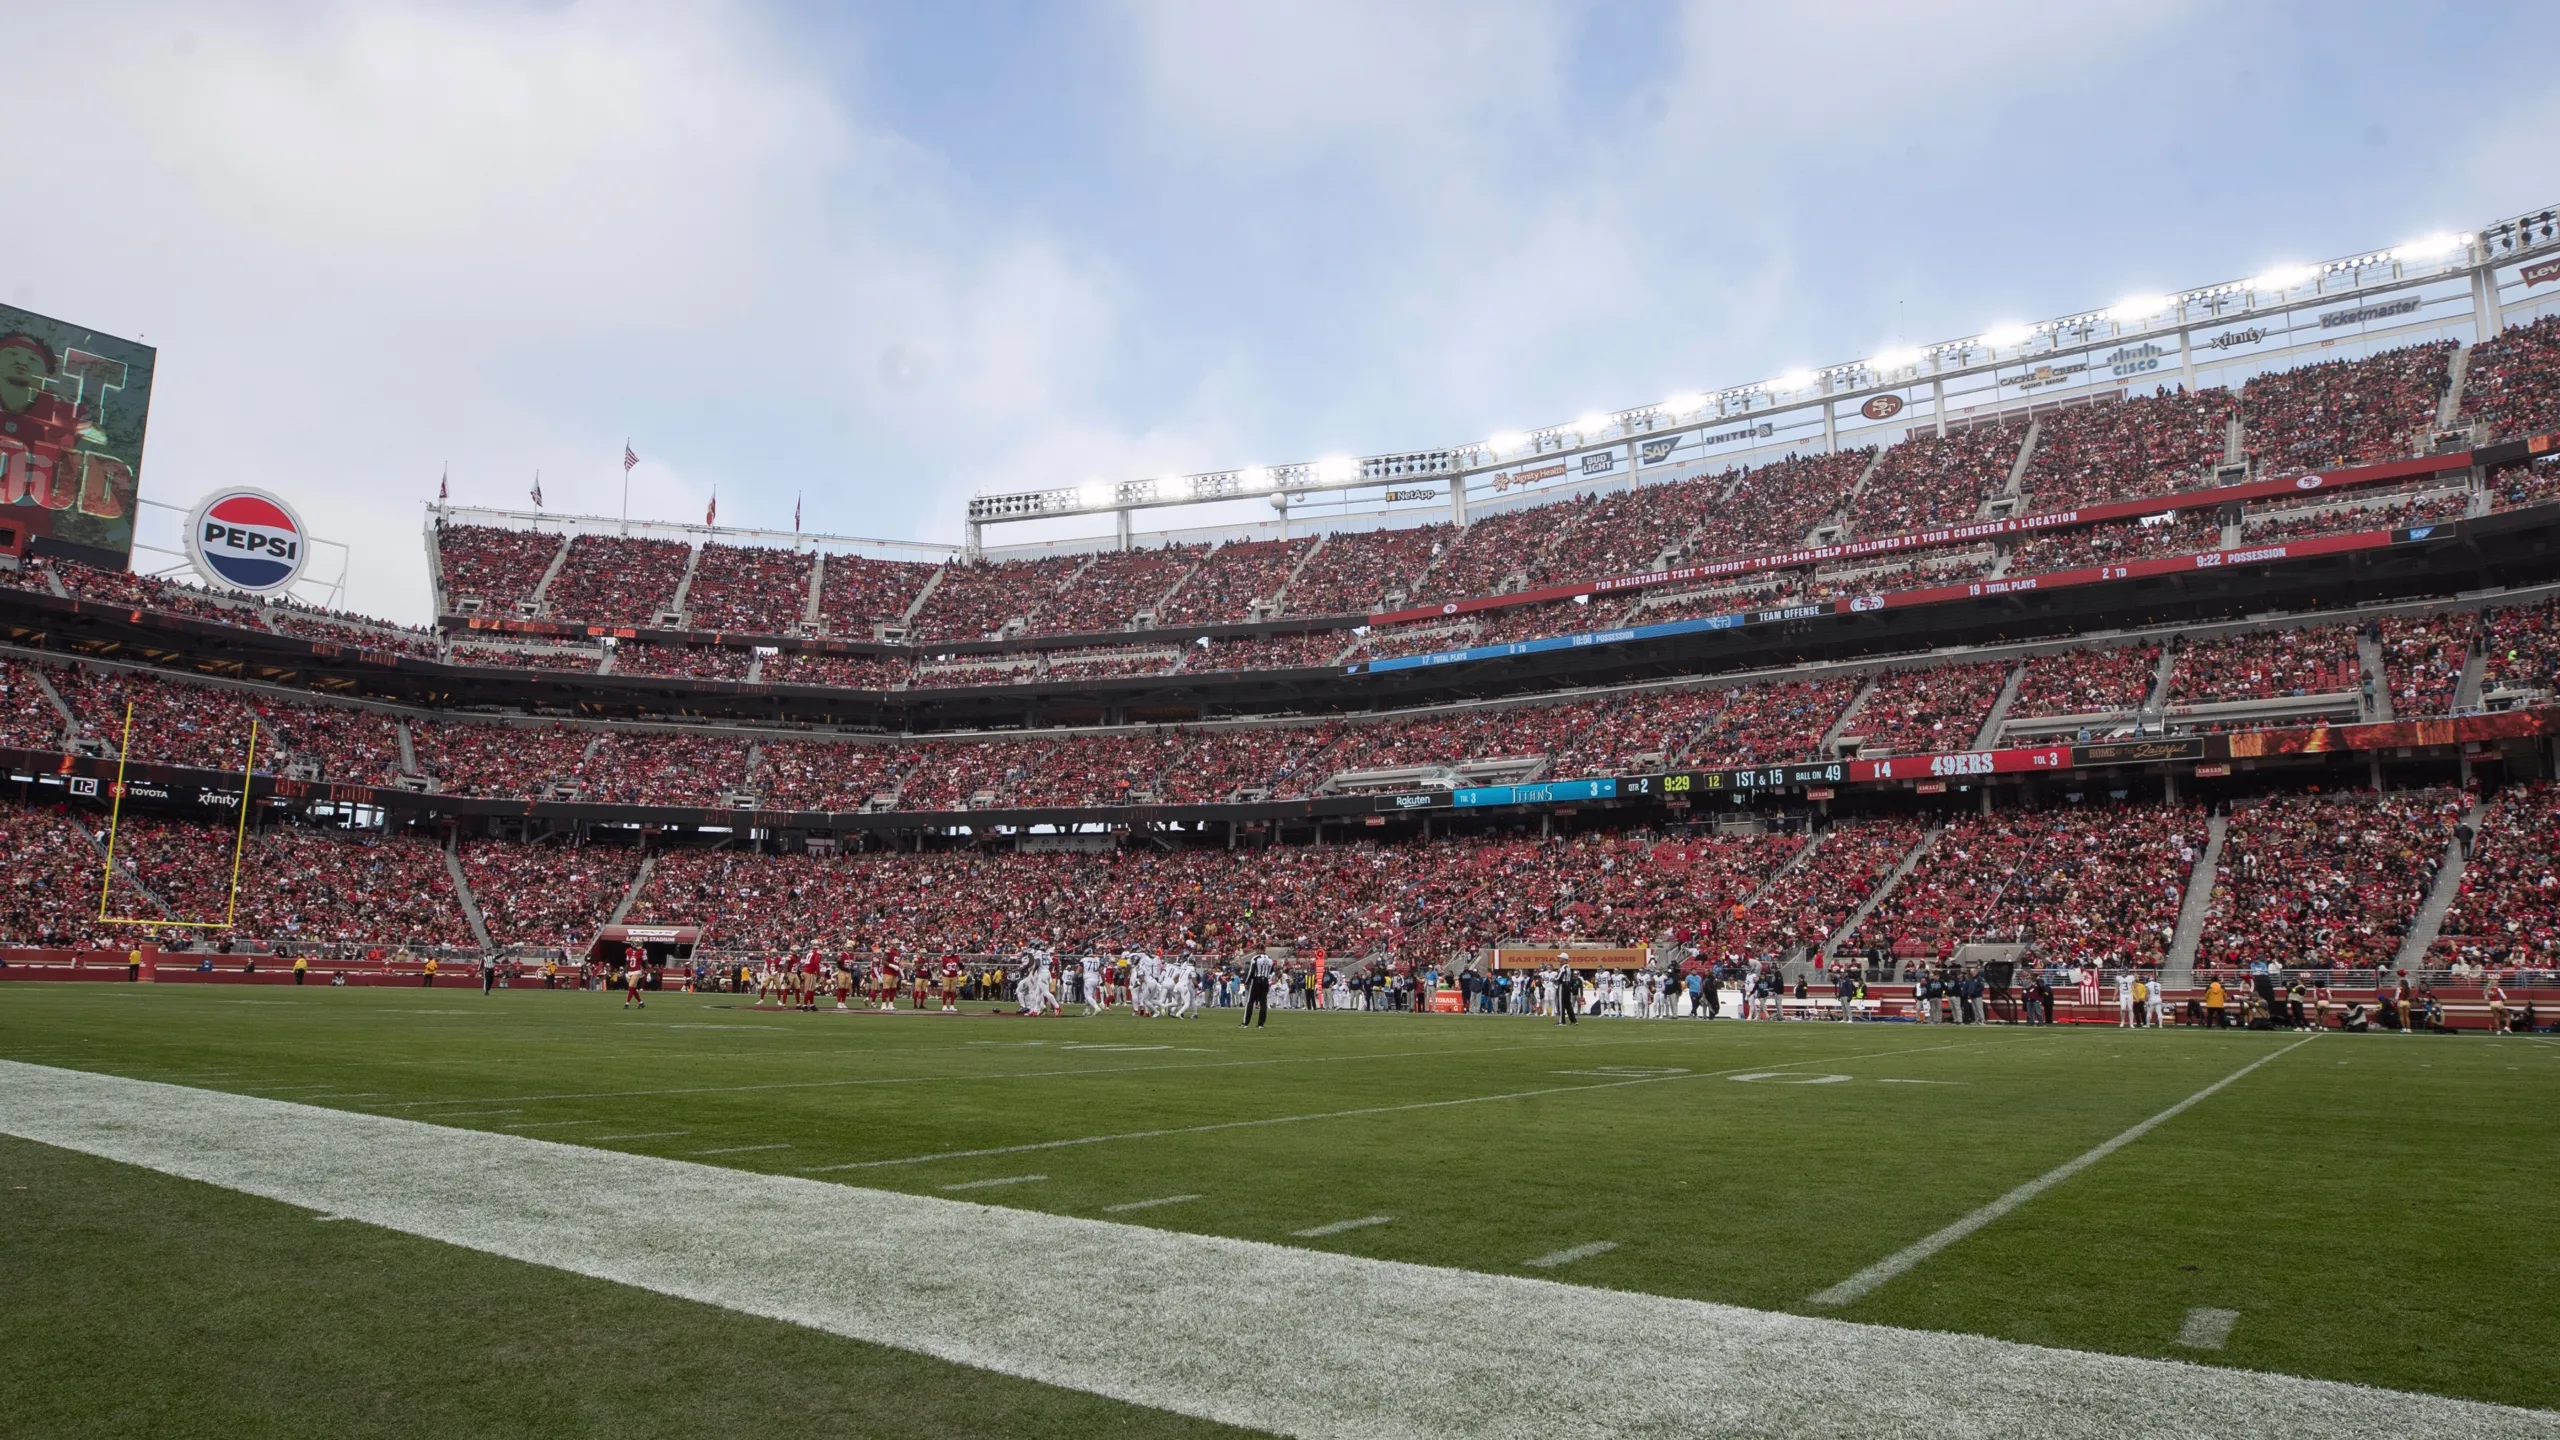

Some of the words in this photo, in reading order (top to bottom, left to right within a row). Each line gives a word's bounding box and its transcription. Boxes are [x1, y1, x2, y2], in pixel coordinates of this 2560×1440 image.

[2321, 300, 2420, 328] ticketmaster
[2211, 327, 2267, 350] xfinity
[2000, 374, 2036, 387] CACHE
[2052, 363, 2088, 377] CREEK
[1706, 428, 1757, 445] UNITED
[1643, 442, 1671, 461] SAP
[1583, 461, 1612, 474] LIGHT
[1586, 454, 1608, 466] BUD
[1512, 471, 1540, 484] Dignity
[1539, 465, 1565, 478] Health
[1397, 490, 1435, 501] NetApp
[205, 523, 297, 560] PEPSI
[2409, 528, 2430, 540] SAP
[1595, 580, 1612, 591] FOR
[1615, 571, 1668, 588] ASSISTANCE
[1671, 568, 1696, 579] TEXT
[1755, 557, 1767, 568] TO
[1845, 537, 1900, 554] FOLLOWED
[1904, 535, 1917, 545] BY
[1921, 530, 1949, 544] YOUR
[1954, 523, 2004, 538] CONCERN
[2008, 520, 2017, 530] &
[2021, 511, 2078, 529] LOCATION
[2196, 553, 2222, 568] 9:22
[2227, 547, 2287, 564] POSSESSION
[2103, 568, 2110, 580] 2
[2115, 567, 2127, 579] TD
[1968, 584, 1981, 596] 19
[1986, 582, 2010, 594] TOTAL
[2011, 578, 2037, 592] PLAYS
[1759, 610, 1782, 622] TEAM
[1784, 605, 1820, 619] OFFENSE
[1596, 630, 1635, 643] POSSESSION
[2089, 747, 2116, 759] HOME
[2133, 743, 2188, 759] Faithful
[1873, 761, 1892, 779] 14
[1930, 752, 1995, 777] 49ERS
[2033, 755, 2047, 765] TOL
[2050, 752, 2059, 767] 3
[79, 780, 94, 793] 12
[1640, 778, 1649, 793] 2
[1664, 775, 1690, 792] 9:29
[1708, 776, 1720, 787] 12
[1735, 771, 1756, 787] 1ST
[1758, 775, 1766, 785] &
[1769, 769, 1783, 785] 15
[1796, 771, 1811, 782] BALL
[1812, 771, 1822, 781] ON
[1825, 765, 1841, 781] 49
[130, 787, 169, 799] TOYOTA
[198, 793, 240, 807] xfinity
[1396, 795, 1431, 806] Rakuten
[1470, 792, 1477, 804] 3
[1590, 781, 1598, 796] 3
[1087, 960, 1099, 972] 70
[1508, 955, 1528, 963] SAN
[1533, 955, 1599, 963] FRAISCO
[1601, 955, 1637, 964] 49ERS
[2123, 982, 2129, 991] 3
